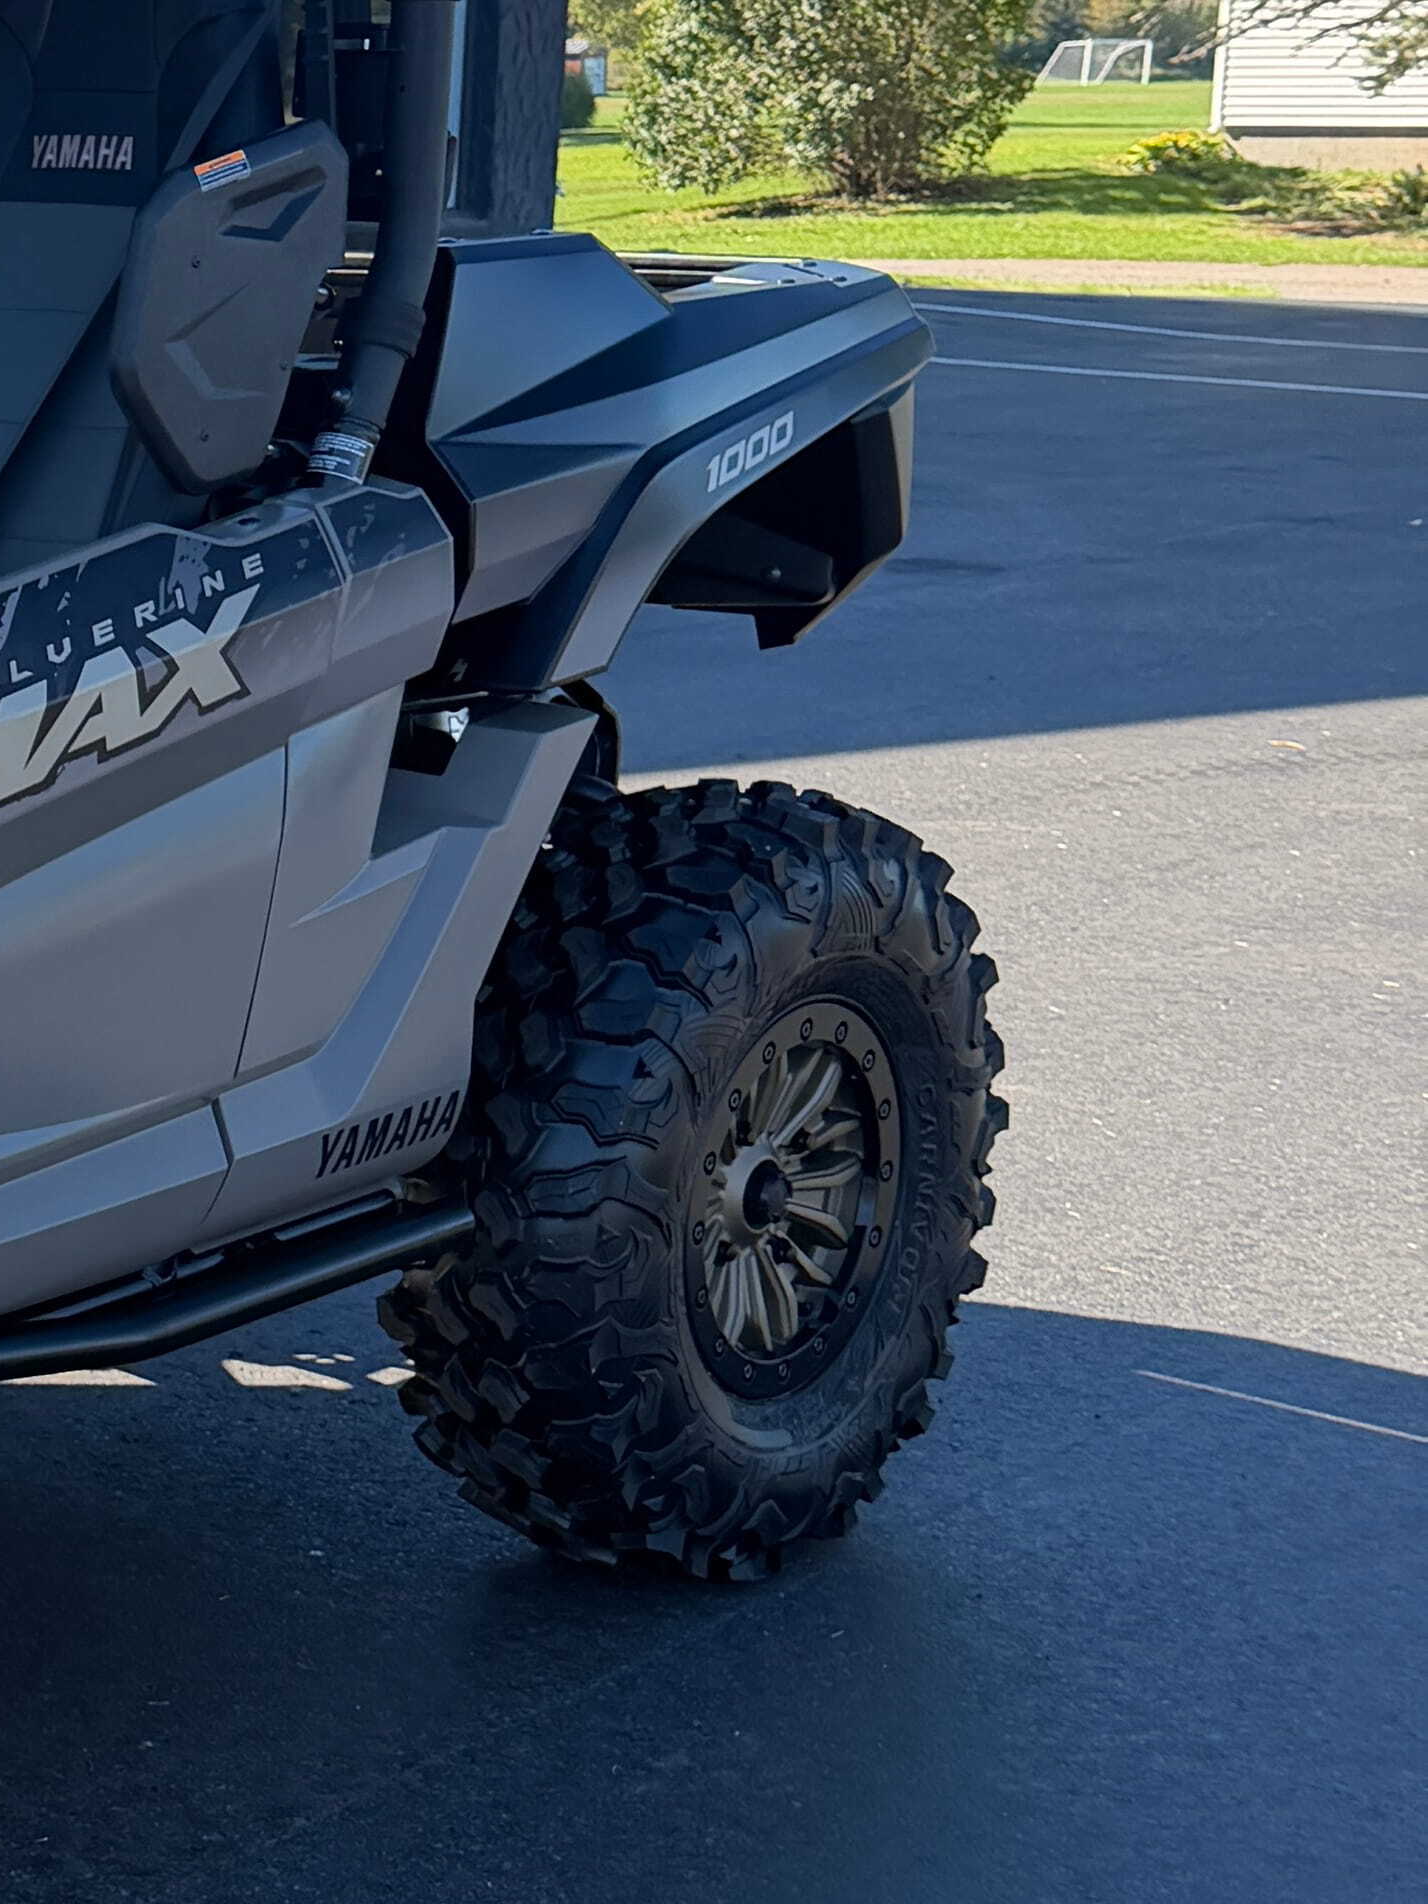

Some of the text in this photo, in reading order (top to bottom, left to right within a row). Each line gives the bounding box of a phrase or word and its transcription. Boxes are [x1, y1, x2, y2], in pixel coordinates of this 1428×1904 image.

[31, 133, 135, 172] YAMAHA
[706, 410, 796, 494] 1000
[315, 1089, 460, 1180] YAMAHA
